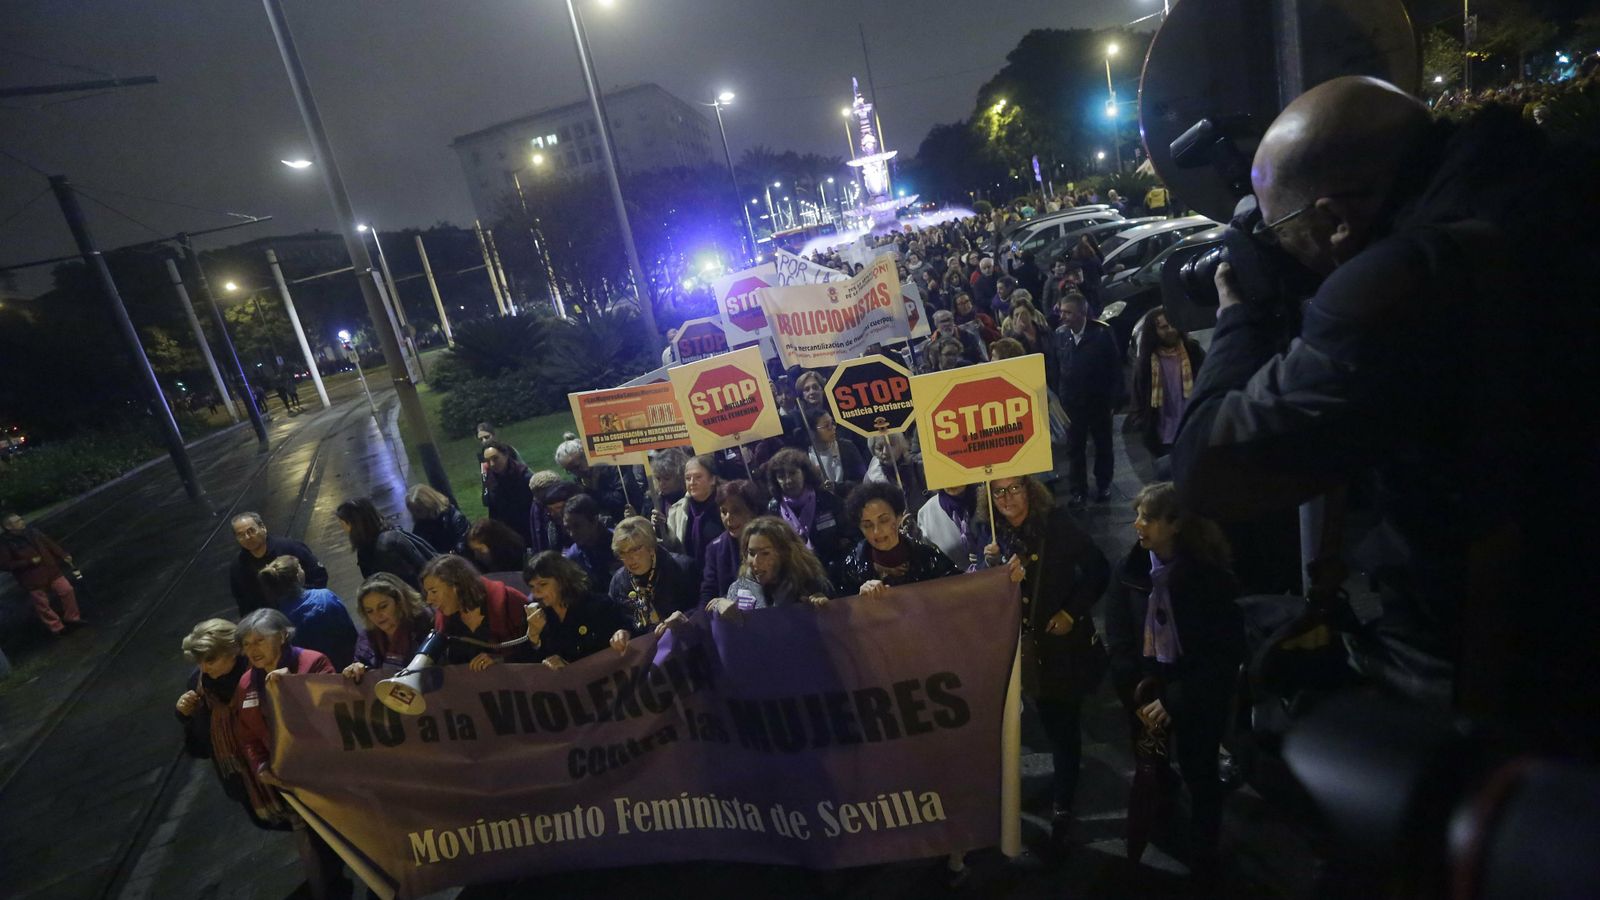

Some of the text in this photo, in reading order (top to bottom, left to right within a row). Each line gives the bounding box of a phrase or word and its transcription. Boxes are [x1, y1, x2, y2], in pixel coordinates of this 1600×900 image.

[780, 254, 807, 281] POR
[727, 288, 760, 315] STO
[680, 334, 726, 357] STOP
[690, 379, 756, 415] STOP
[834, 377, 908, 410] STOP
[703, 414, 728, 425] GENITAL
[842, 400, 913, 418] Justicia Patriarcal
[934, 397, 1029, 440] STOP
[968, 434, 1024, 453] FEMINICIDIO
[979, 422, 1023, 439] IMPUNIDAD
[333, 698, 406, 751] NO
[417, 716, 440, 743] a
[443, 708, 477, 741] la
[567, 671, 971, 780] contra las MUJERES
[407, 789, 947, 867] Movimiento Feminista de Sevilla
